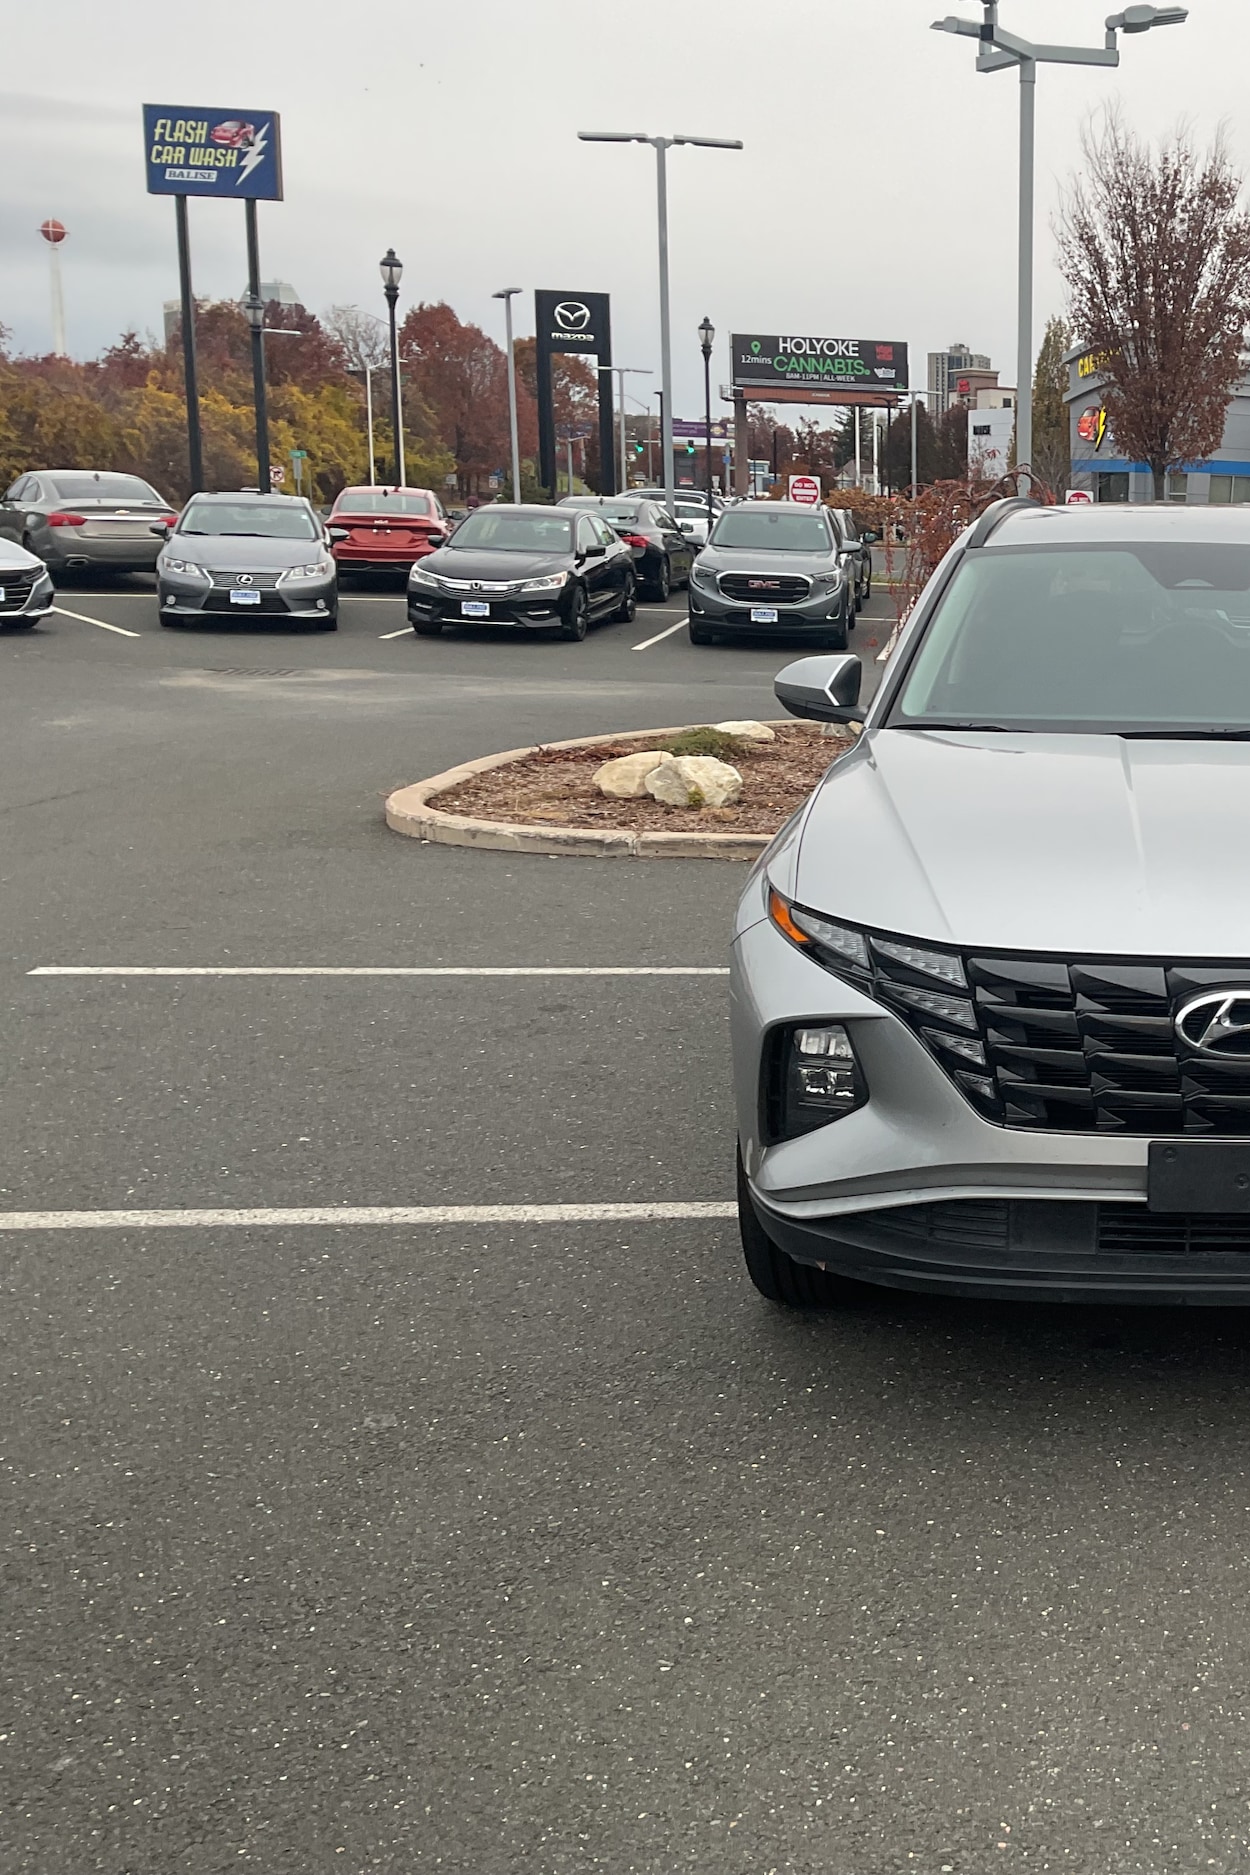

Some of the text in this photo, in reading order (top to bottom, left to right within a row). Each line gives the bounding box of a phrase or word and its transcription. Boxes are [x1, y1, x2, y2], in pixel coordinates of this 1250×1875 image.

[153, 119, 208, 144] FLASH
[150, 145, 238, 167] CAR WASH
[167, 170, 215, 180] BALISE
[551, 332, 595, 342] mazda
[778, 337, 860, 357] HOLYOKE
[740, 354, 773, 365] 12mins
[773, 355, 865, 375] CANNABIS
[823, 374, 856, 382] ALL-WEEK
[748, 579, 781, 589] GMC
